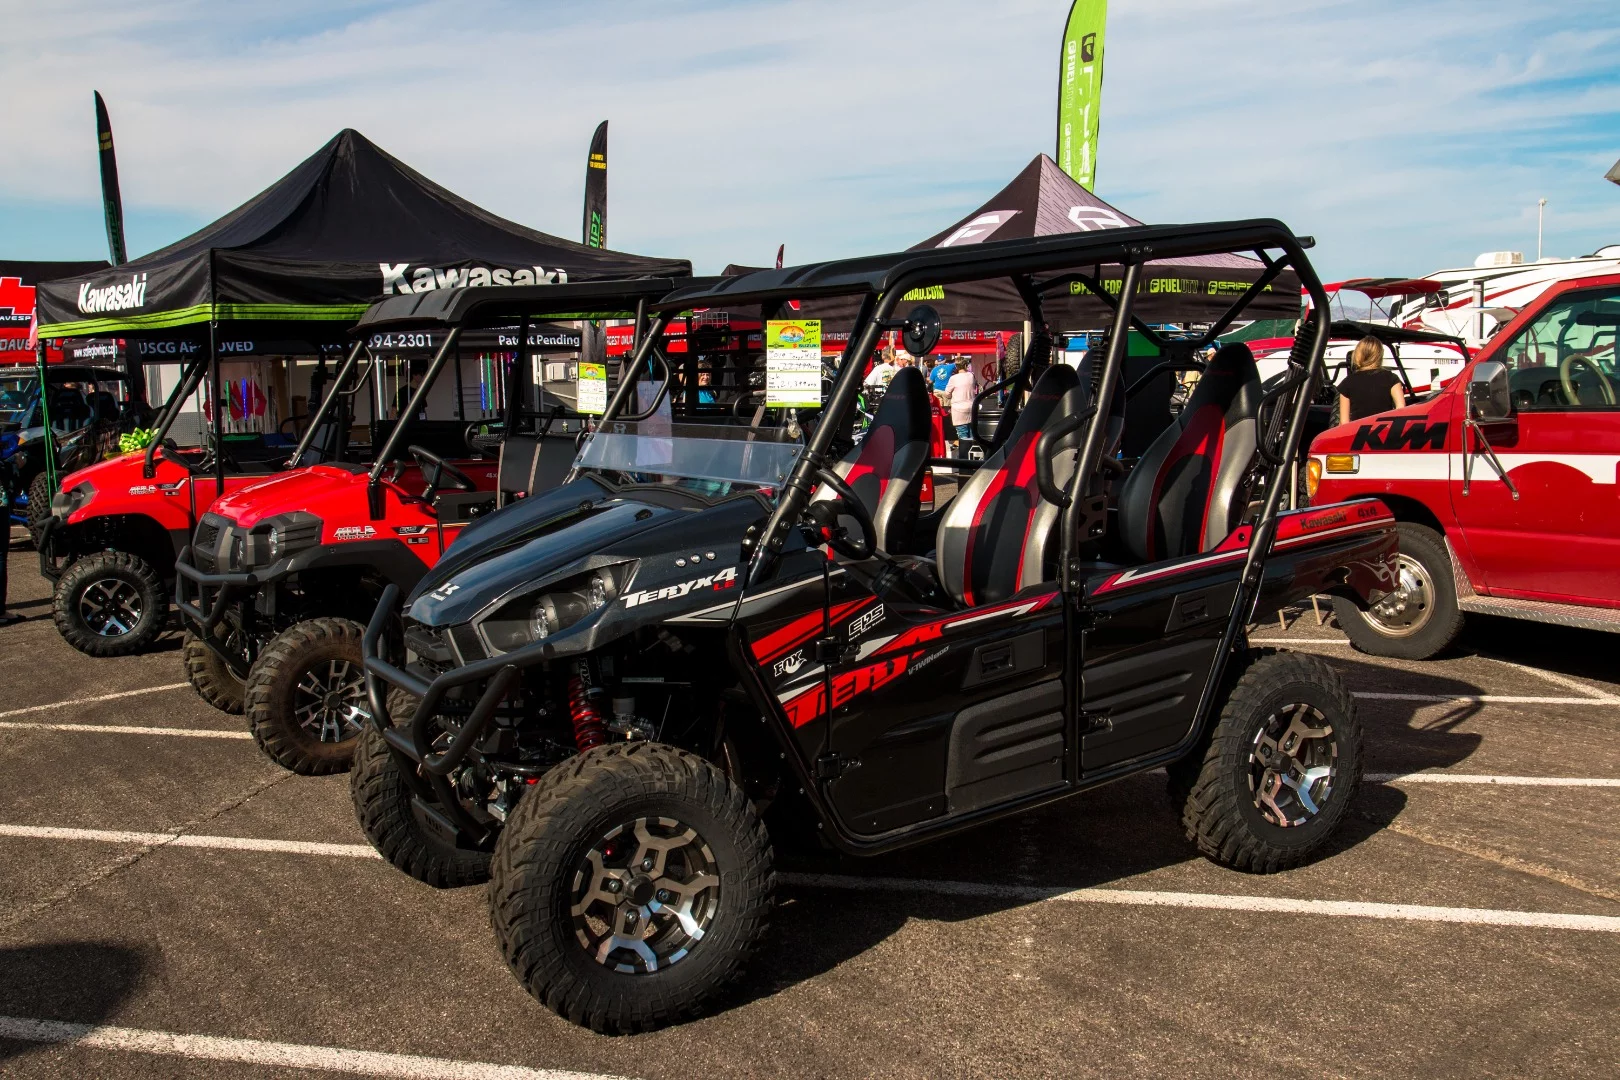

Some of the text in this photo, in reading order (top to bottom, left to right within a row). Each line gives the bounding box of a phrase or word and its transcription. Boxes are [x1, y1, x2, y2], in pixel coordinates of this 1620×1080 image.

[379, 263, 568, 294] Kawasaki
[1219, 281, 1272, 292] GRIPPR
[78, 273, 147, 314] Kawasaki
[139, 342, 176, 354] USCG
[537, 335, 580, 346] Pending
[1351, 415, 1449, 450] KTM
[1300, 506, 1378, 530] Kawasaki 4x4
[334, 525, 377, 538] MULE
[713, 580, 736, 591] LE
[848, 603, 884, 636] EPS
[774, 650, 807, 677] FOX
